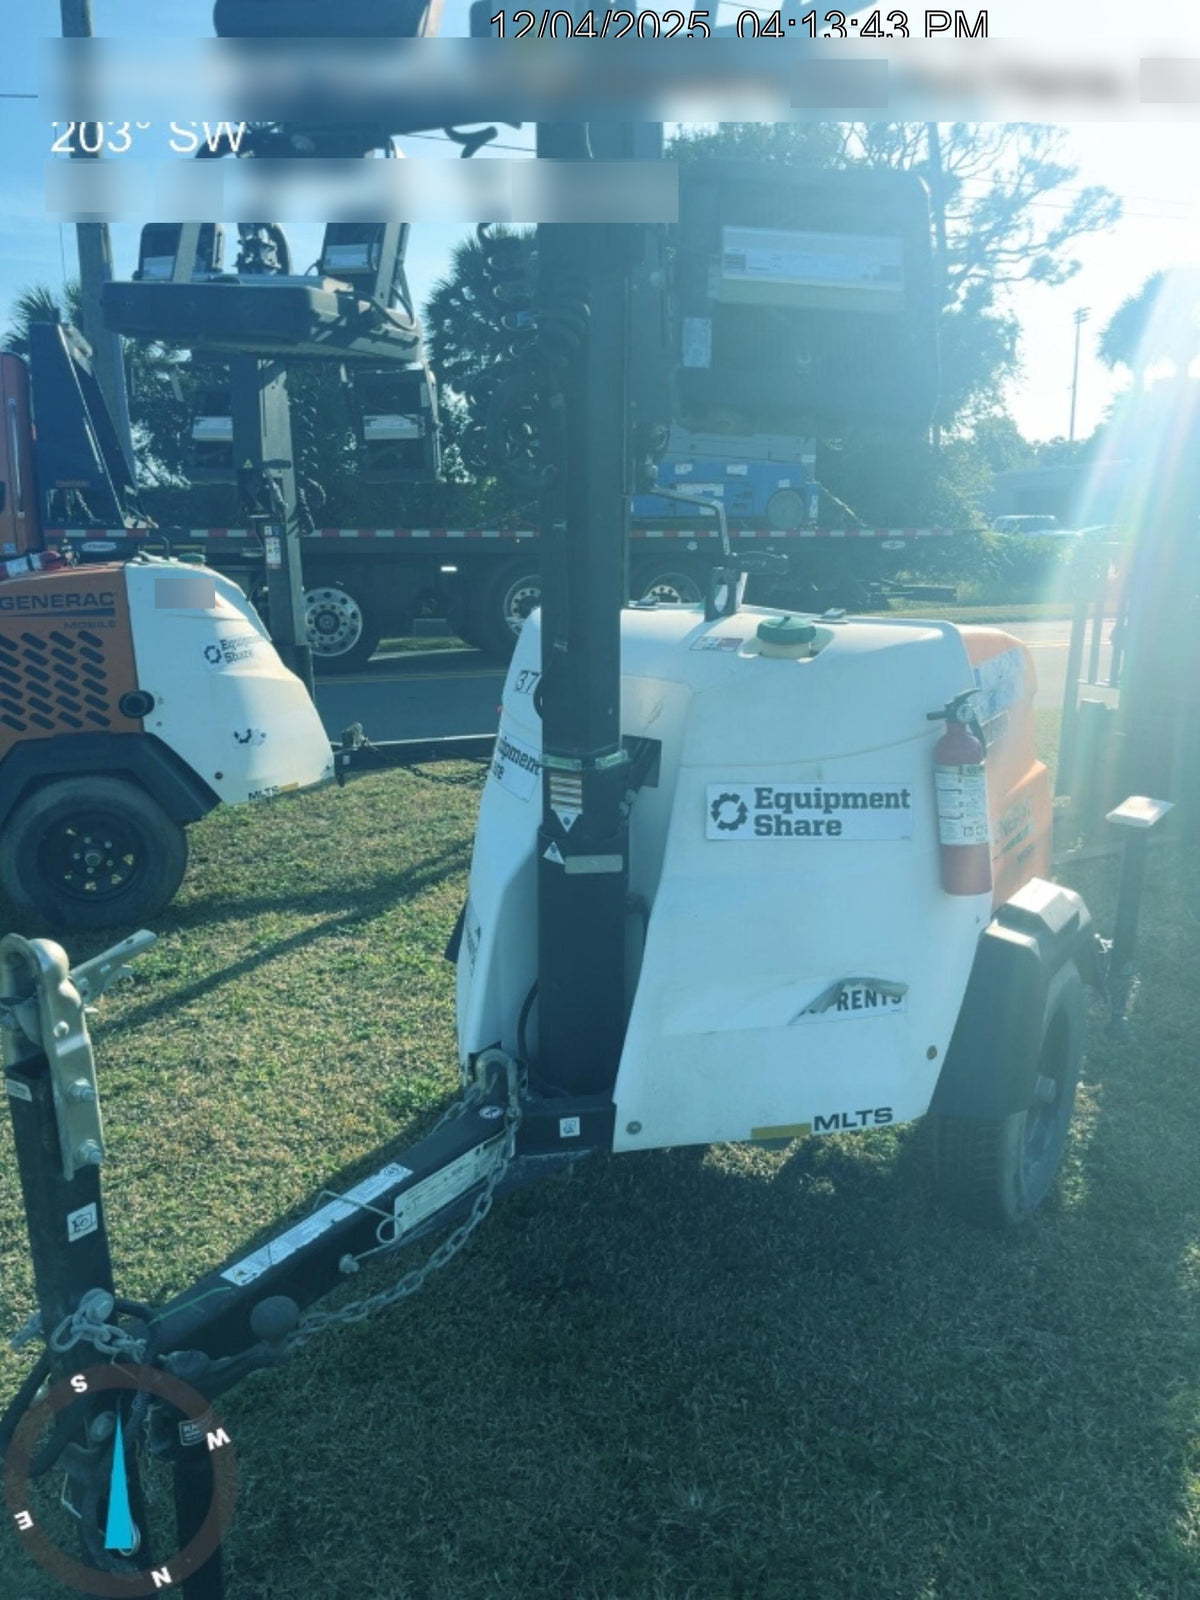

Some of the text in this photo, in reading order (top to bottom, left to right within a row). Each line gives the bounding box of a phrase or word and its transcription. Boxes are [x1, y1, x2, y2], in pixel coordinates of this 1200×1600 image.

[0, 592, 115, 610] GENERAC
[754, 787, 911, 815] Equipment
[754, 814, 843, 837] Share
[814, 1107, 893, 1132] MLTS
